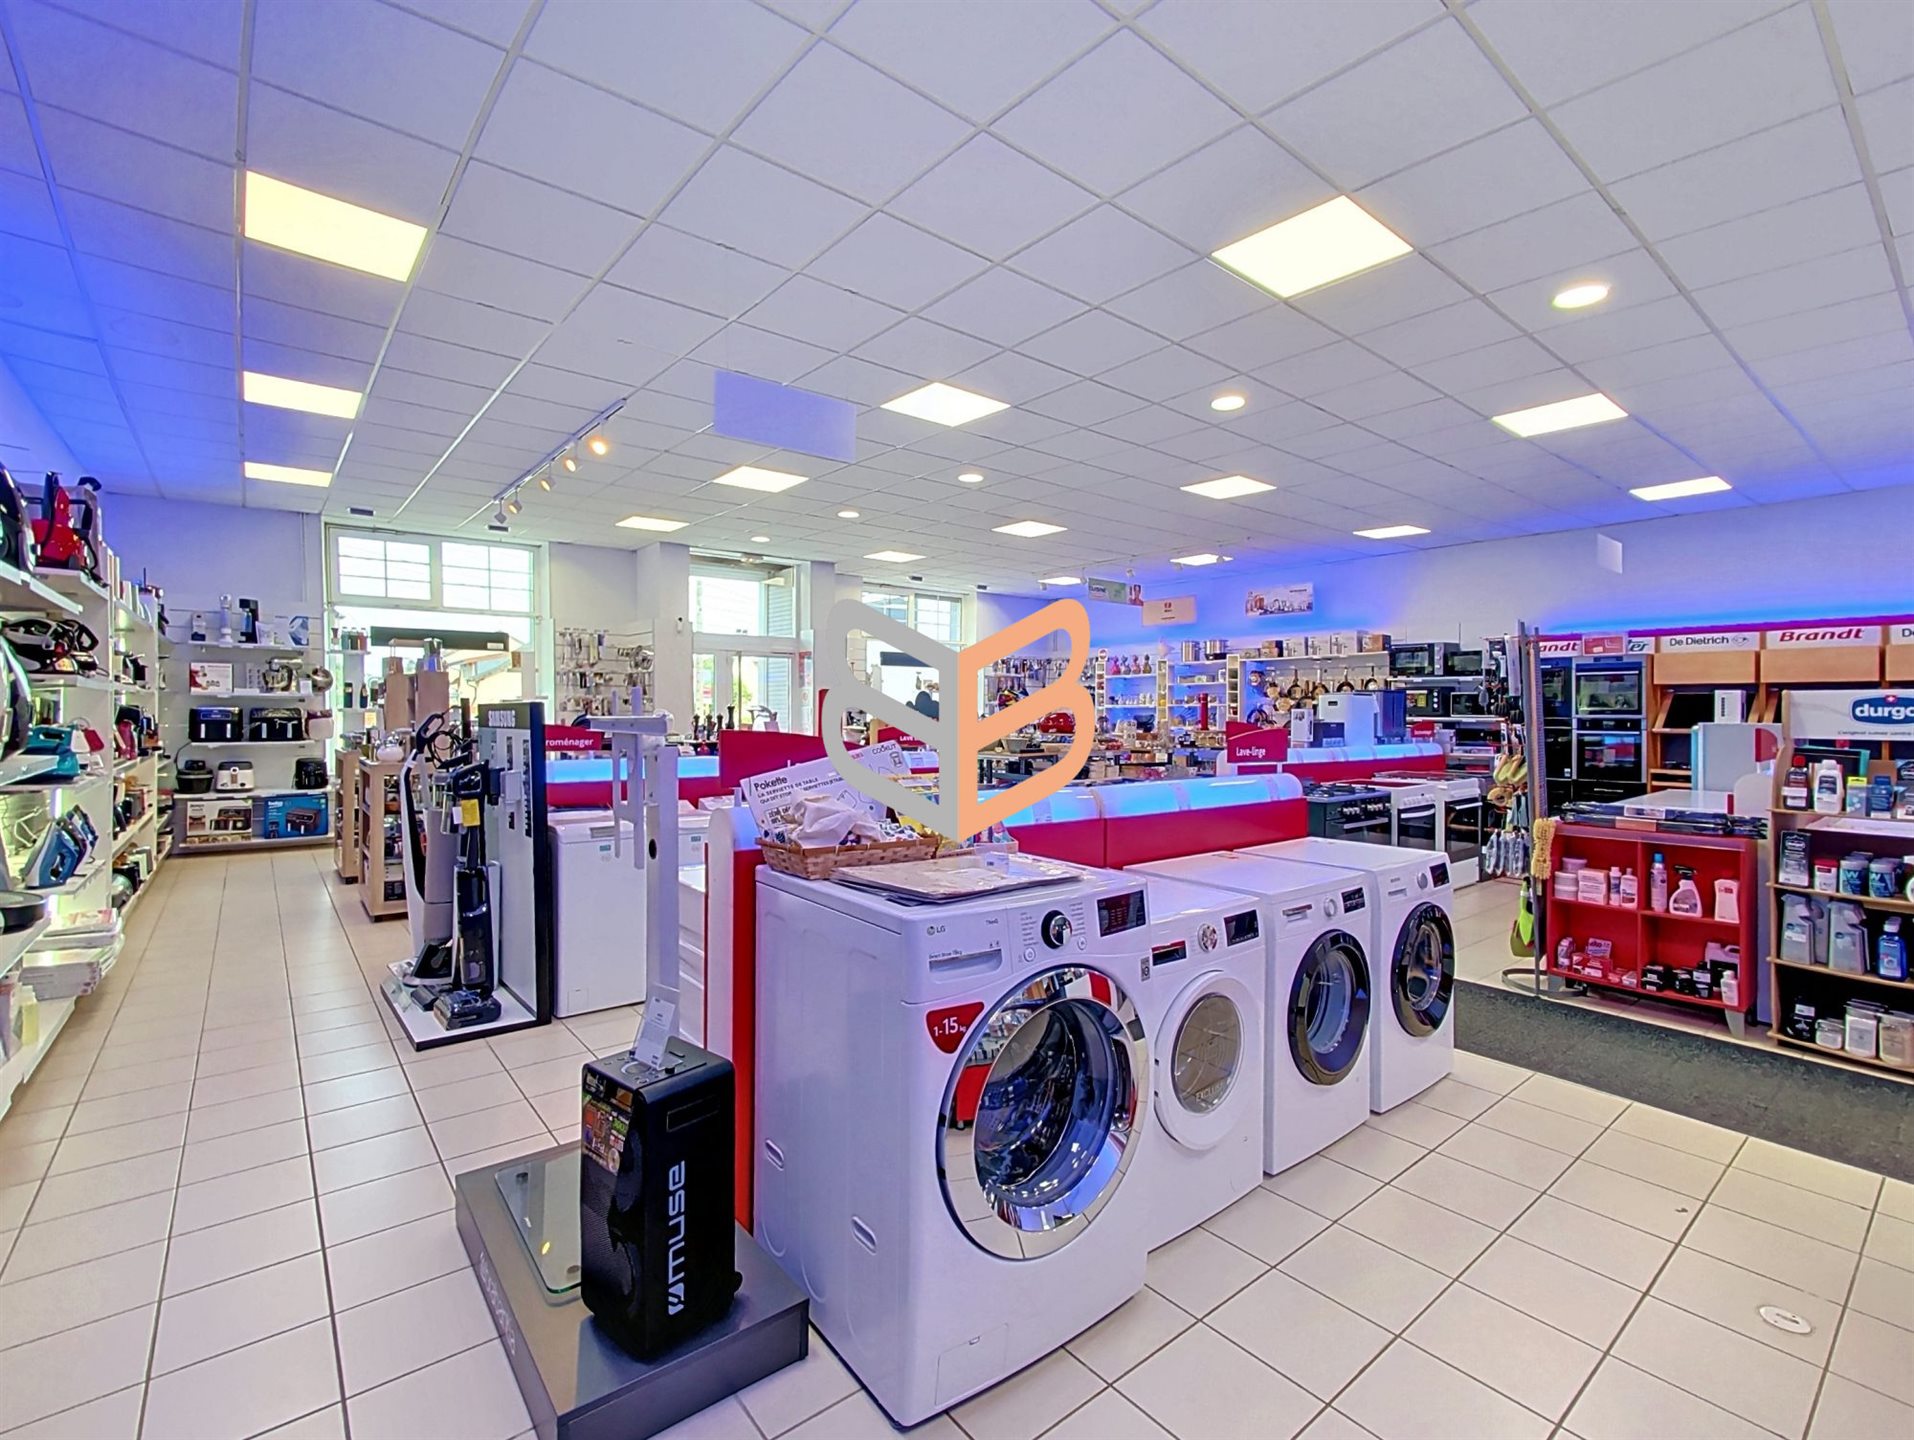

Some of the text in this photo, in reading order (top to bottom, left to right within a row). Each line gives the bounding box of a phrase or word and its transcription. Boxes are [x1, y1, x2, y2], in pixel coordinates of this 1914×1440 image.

[1669, 635, 1730, 647] De Dietrich
[1779, 628, 1865, 642] Brandt
[488, 710, 516, 728] SAMSUNG
[1236, 746, 1266, 759] Lave-linge
[753, 776, 788, 791] Pokette
[766, 784, 794, 795] SERVIETTE
[802, 777, 818, 785] TABLE
[936, 926, 946, 934] LG
[668, 1160, 685, 1285] muse
